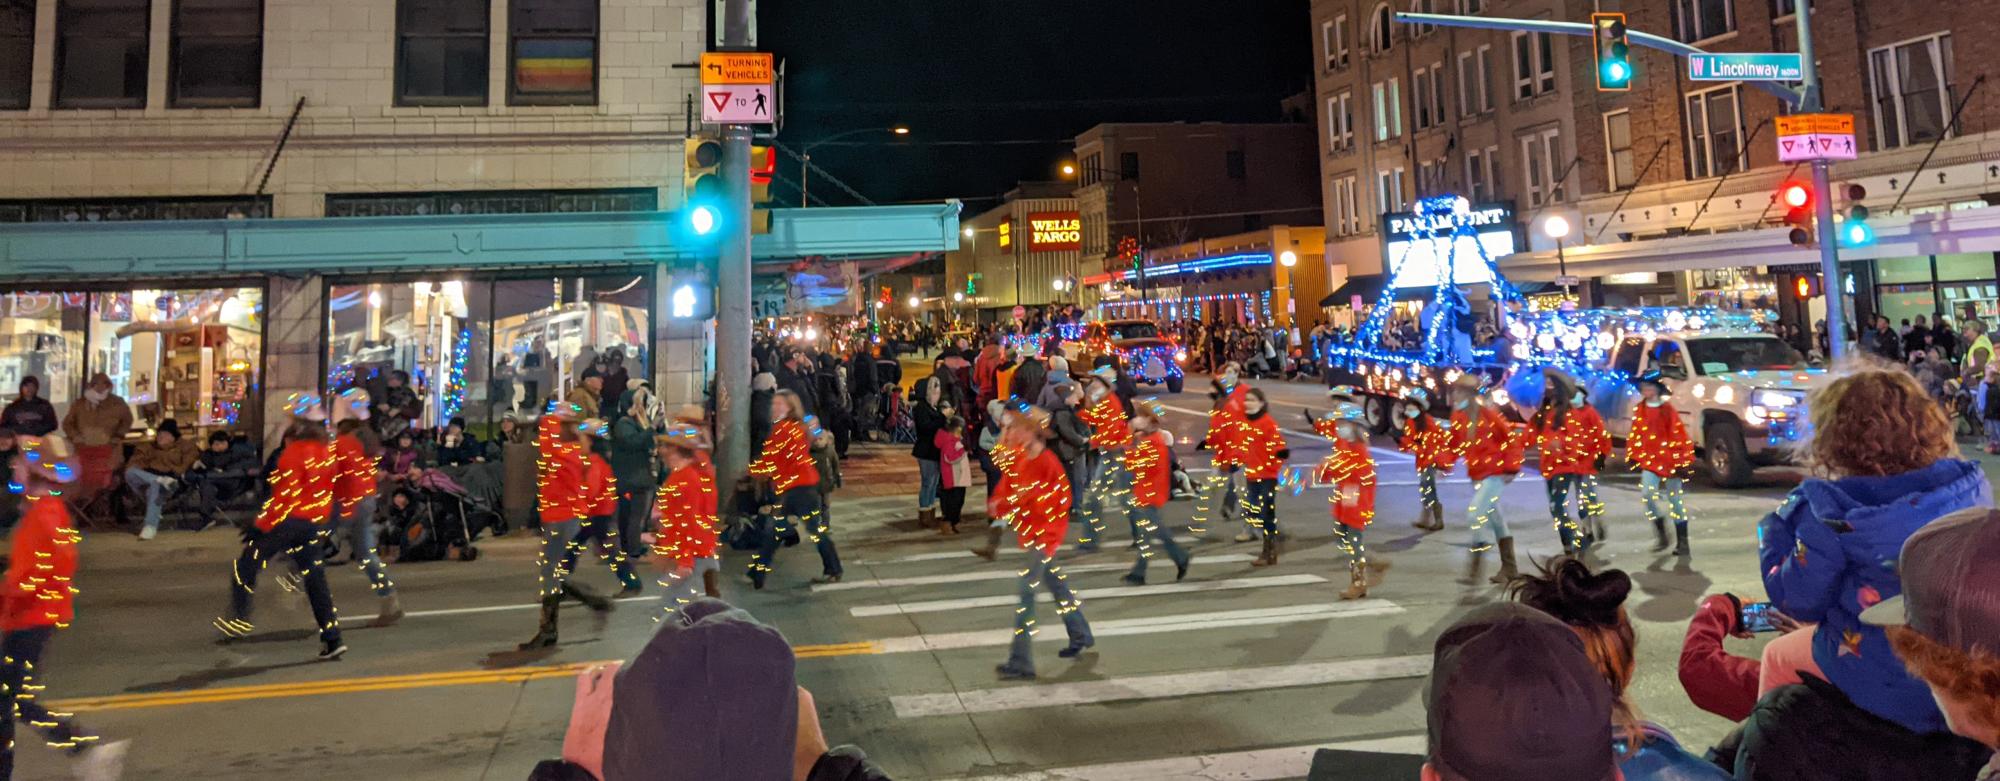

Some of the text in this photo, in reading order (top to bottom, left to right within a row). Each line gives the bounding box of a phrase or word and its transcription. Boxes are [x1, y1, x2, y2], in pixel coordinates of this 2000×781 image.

[728, 58, 767, 67] TURNING
[1692, 57, 1704, 76] W
[1711, 57, 1779, 78] Lincolnway
[725, 70, 768, 79] VEHICLES
[735, 98, 746, 107] TO
[1031, 219, 1080, 231] WELLS
[1032, 231, 1080, 243] FARGO
